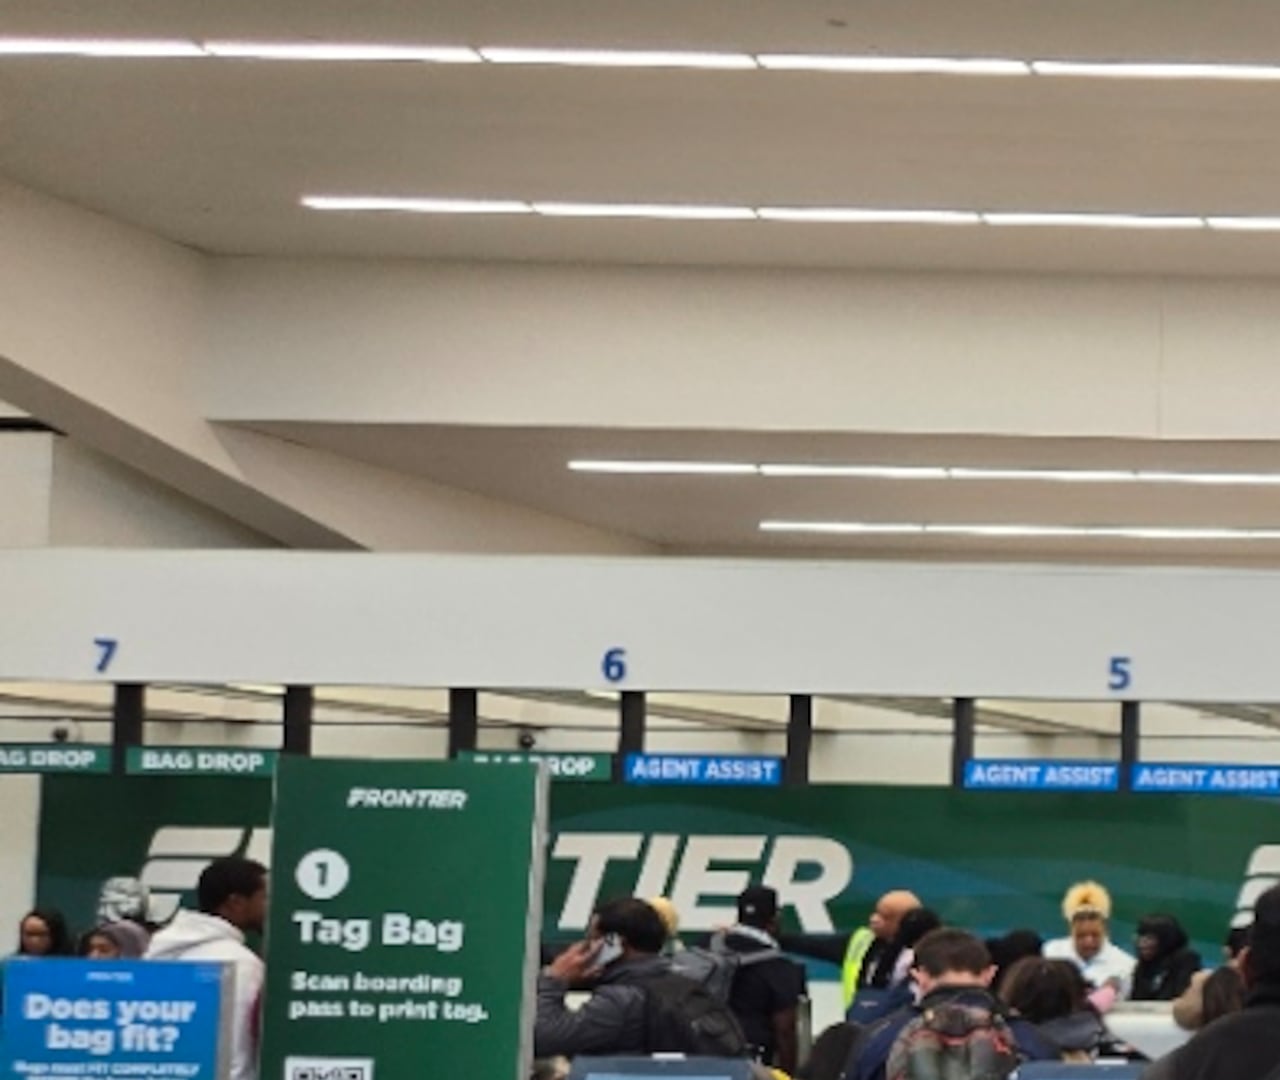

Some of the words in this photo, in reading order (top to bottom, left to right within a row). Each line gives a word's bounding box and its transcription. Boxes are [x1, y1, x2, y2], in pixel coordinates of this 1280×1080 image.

[93, 638, 118, 673] 7
[602, 648, 626, 682] 6
[1108, 657, 1131, 690] 5
[30, 750, 96, 766] DROP
[142, 752, 192, 769] BAG
[197, 753, 264, 771] DROP
[632, 760, 700, 778] AGENT
[704, 761, 777, 779] ASSIST
[971, 767, 1039, 784] AGENT
[1044, 768, 1117, 786] ASSIST
[1137, 769, 1206, 787] AGENT
[1210, 771, 1280, 789] ASSIST
[347, 787, 467, 810] FRONTIER
[315, 862, 329, 886] 1
[292, 912, 371, 951] Tag
[382, 913, 464, 951] Bag
[291, 971, 349, 991] Scan
[354, 971, 462, 997] boarding
[24, 993, 110, 1020] Does
[116, 999, 197, 1026] your
[289, 1001, 344, 1020] pass
[350, 1001, 375, 1017] to
[379, 1000, 438, 1022] print
[443, 1002, 489, 1023] tag.
[46, 1023, 115, 1055] bag
[121, 1024, 180, 1051] fit?
